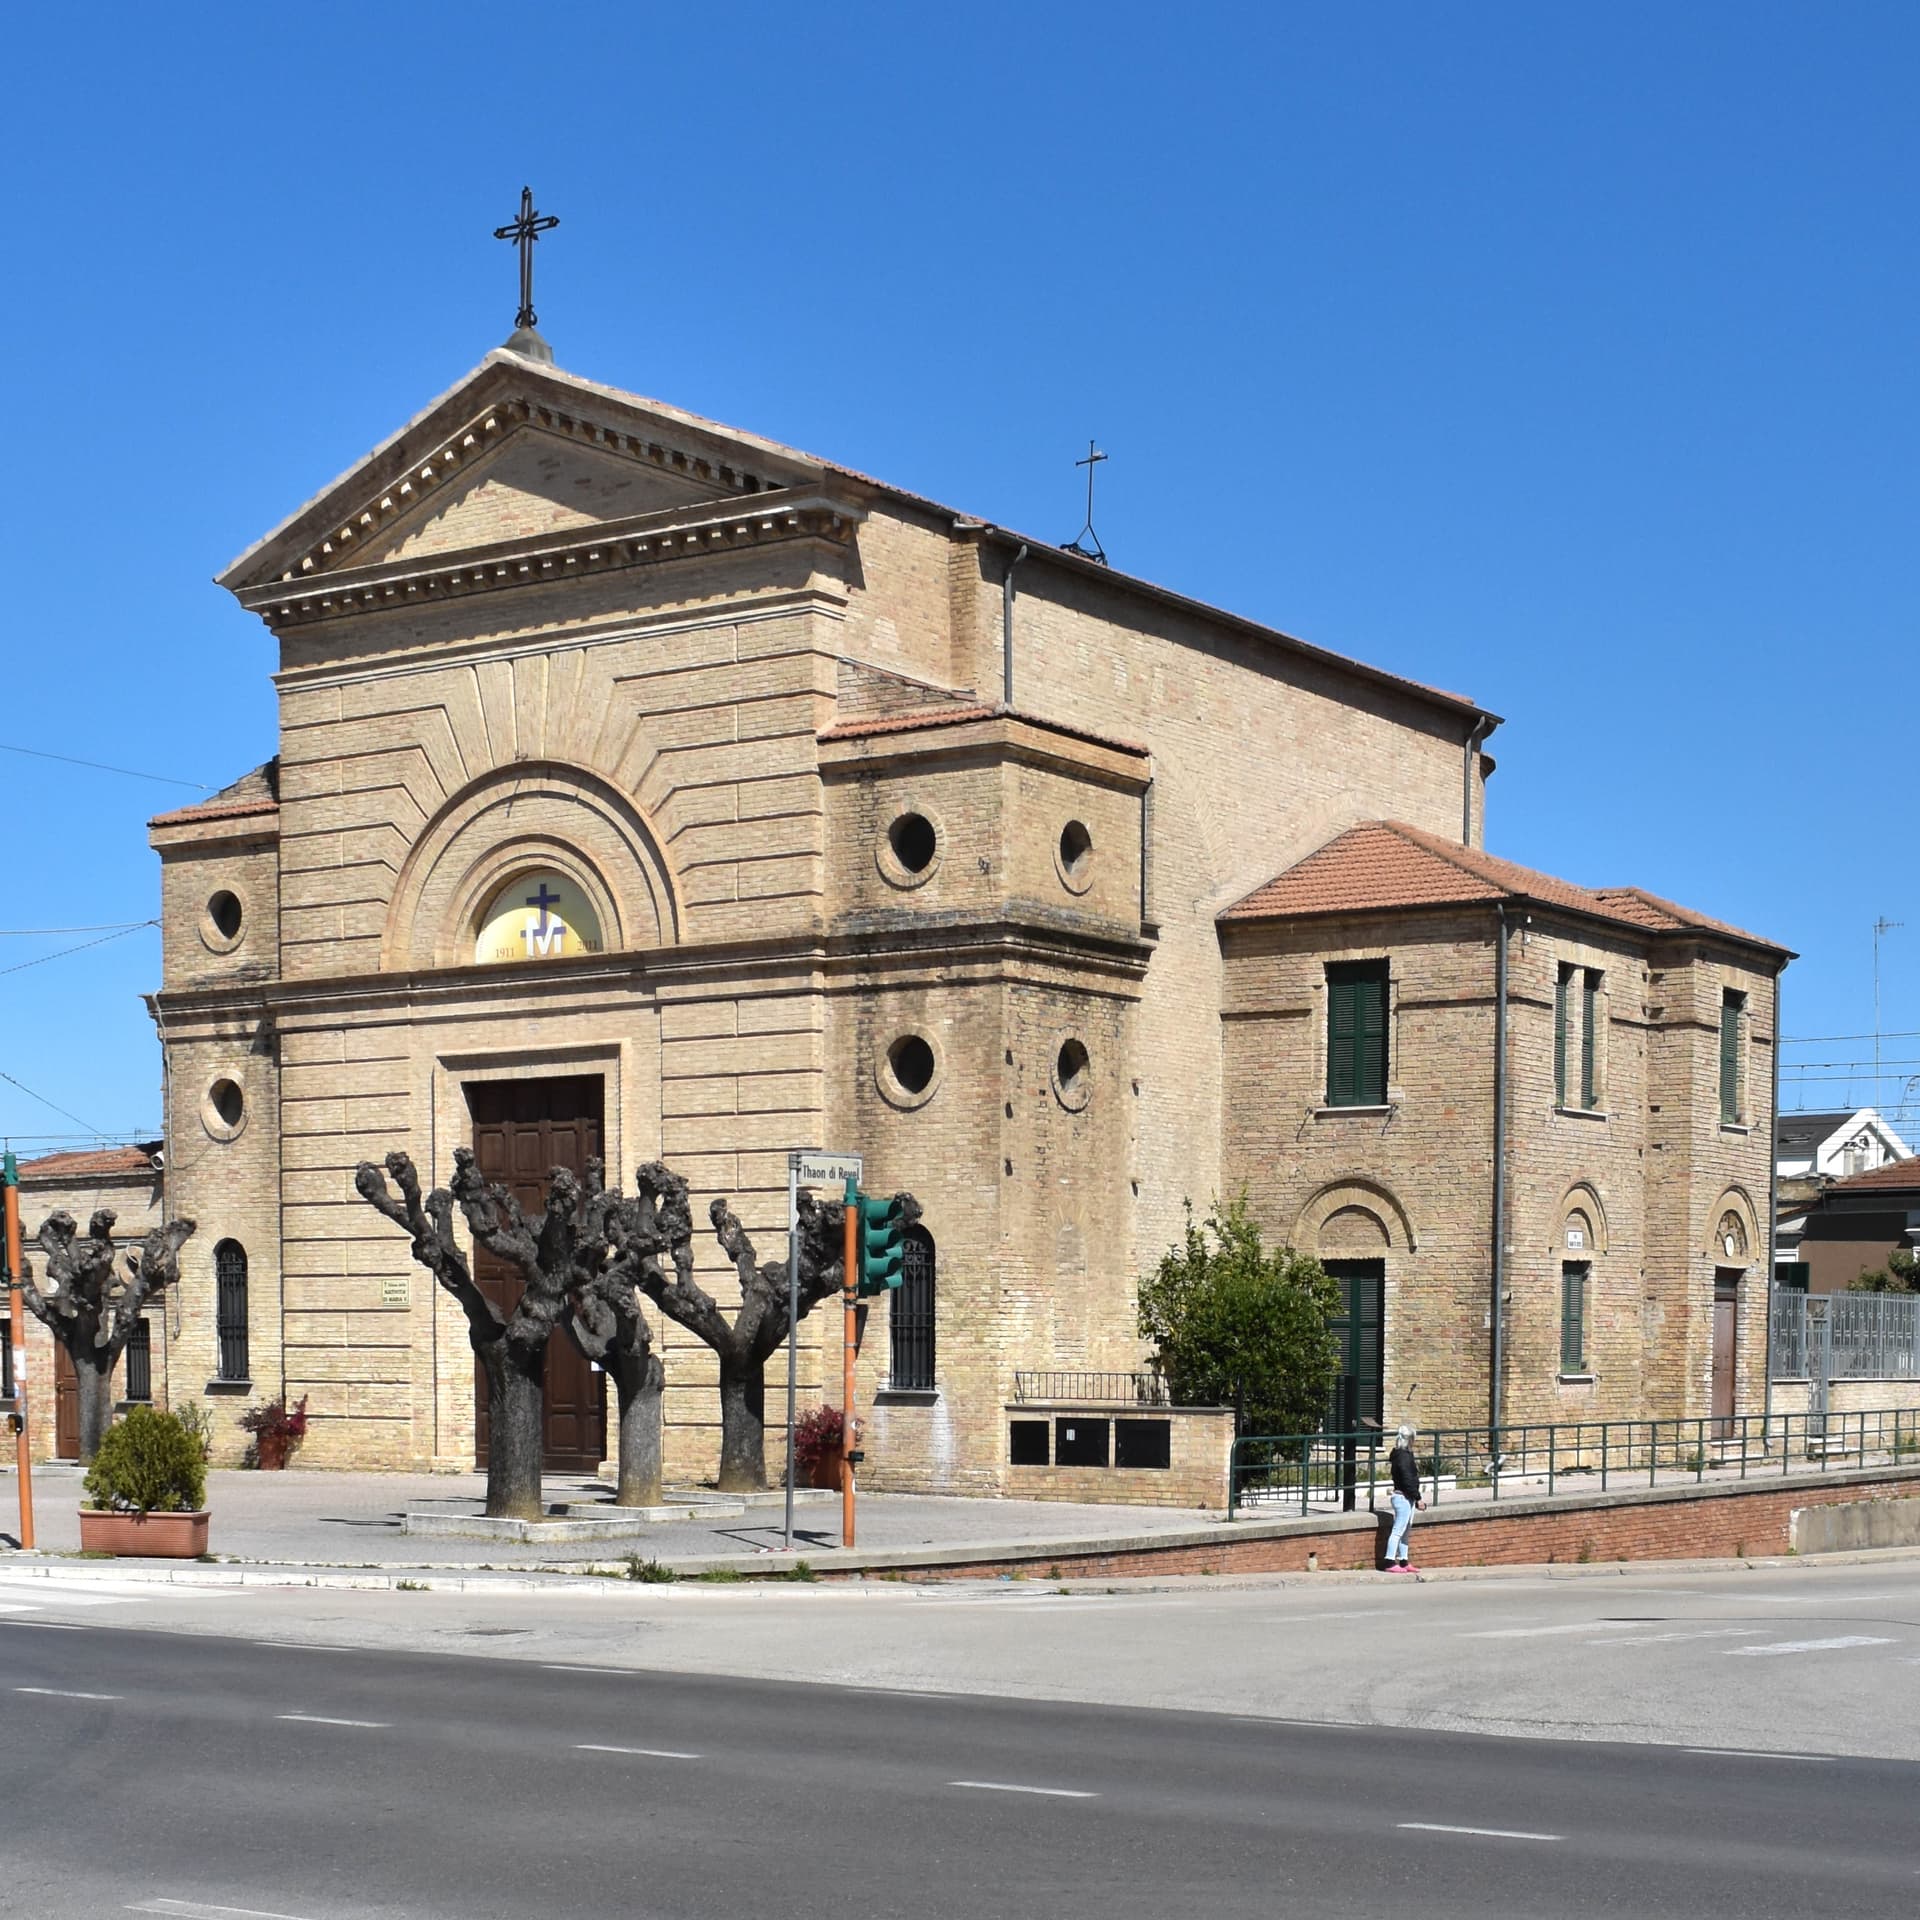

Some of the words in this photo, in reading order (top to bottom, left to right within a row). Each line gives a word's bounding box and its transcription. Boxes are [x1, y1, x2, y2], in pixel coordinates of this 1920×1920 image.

[495, 947, 515, 959] 1911
[803, 1164, 826, 1179] Thaon
[829, 1166, 836, 1180] di
